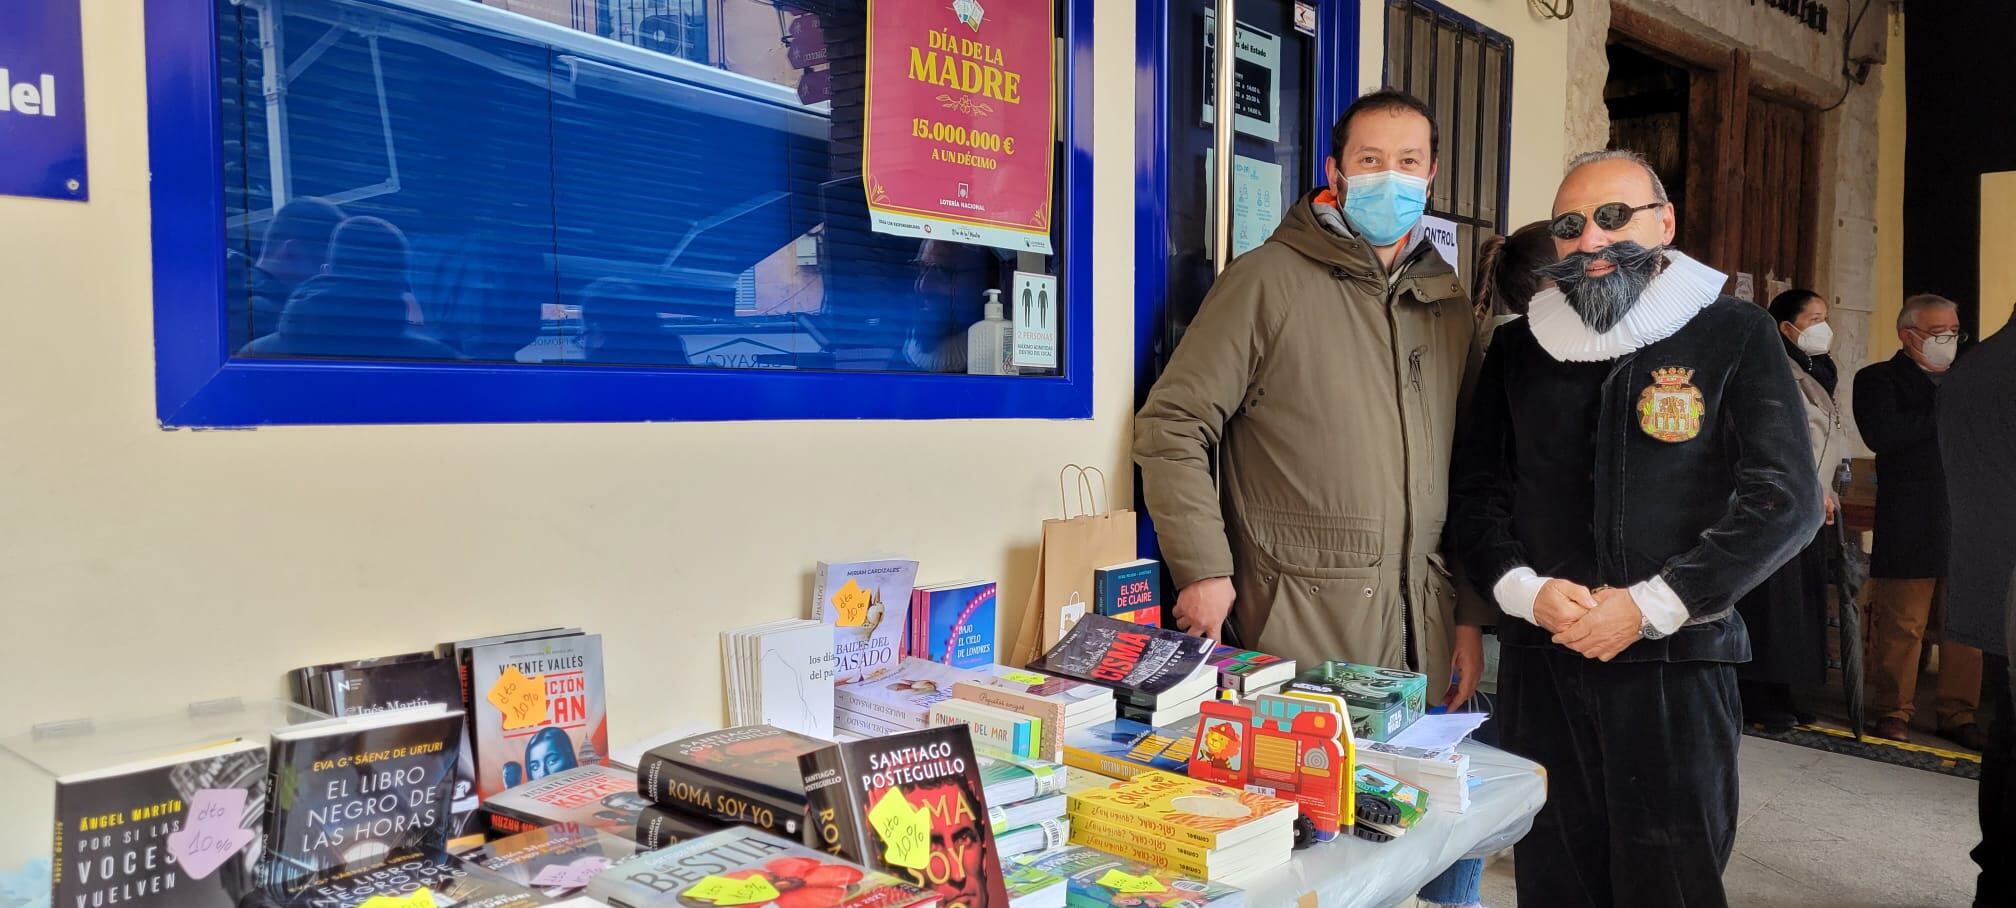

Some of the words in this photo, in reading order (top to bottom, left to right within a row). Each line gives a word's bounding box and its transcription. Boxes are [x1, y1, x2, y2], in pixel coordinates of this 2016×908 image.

[929, 28, 958, 52] DÍA
[961, 37, 982, 57] DE
[985, 44, 1004, 66] LA
[908, 47, 1021, 104] MADRE
[911, 117, 1001, 152] 15.000.000
[1003, 136, 1015, 155] €
[931, 149, 940, 160] A
[941, 150, 956, 164] UN
[957, 152, 997, 170] DÉCIMO
[939, 198, 960, 208] LOTERÍA
[960, 202, 985, 212] NACIONAL
[1424, 227, 1455, 247] ONTROL
[1023, 332, 1053, 341] PERSONAS
[1117, 597, 1127, 608] DE
[1128, 591, 1152, 606] CLAIRE
[1120, 585, 1129, 596] EL
[1129, 581, 1149, 595] SOFÁ
[958, 625, 973, 634] BAJO
[958, 638, 966, 646] EL
[966, 634, 981, 646] CIELO
[871, 636, 890, 647] DEL
[957, 650, 965, 659] DE
[966, 643, 991, 657] LONDRES
[547, 655, 583, 671] VALLÉS
[809, 656, 821, 665] los
[1090, 632, 1152, 681] CISMA
[809, 671, 822, 680] del
[500, 682, 517, 705] dto
[512, 692, 539, 721] 10%
[680, 728, 761, 751] SANTIAGO
[974, 722, 988, 736] DEL
[991, 728, 1008, 742] MAR
[313, 760, 334, 772] EVA
[355, 749, 389, 765] SÁENZ
[393, 747, 407, 758] DE
[410, 742, 443, 755] URTURI
[870, 742, 951, 771] SANTIAGO
[327, 779, 349, 800] EL
[360, 766, 425, 794] LIBRO
[804, 768, 835, 784] SANTIAGO
[805, 776, 842, 792] POSTEGUILLO
[862, 758, 965, 791] POSTEGUILLO
[80, 812, 125, 832] ÁNGEL
[131, 799, 182, 822] MARTÍN
[198, 802, 226, 821] dto
[308, 794, 398, 828] NEGRO
[409, 786, 437, 808] DE
[668, 779, 712, 809] ROMA
[716, 795, 748, 820] SOY
[751, 806, 774, 829] YO
[78, 834, 112, 853] POR
[123, 829, 140, 844] SI
[152, 819, 180, 838] LAS
[303, 828, 344, 853] LAS
[354, 809, 436, 841] HORAS
[884, 815, 899, 838] dto
[895, 824, 924, 862] 10%
[626, 835, 788, 894] BESTIA
[76, 872, 176, 908] VUELVEN
[311, 874, 410, 907] NEGRO
[420, 862, 451, 876] DE
[318, 882, 347, 896] EL
[352, 862, 423, 886] LIBRO
